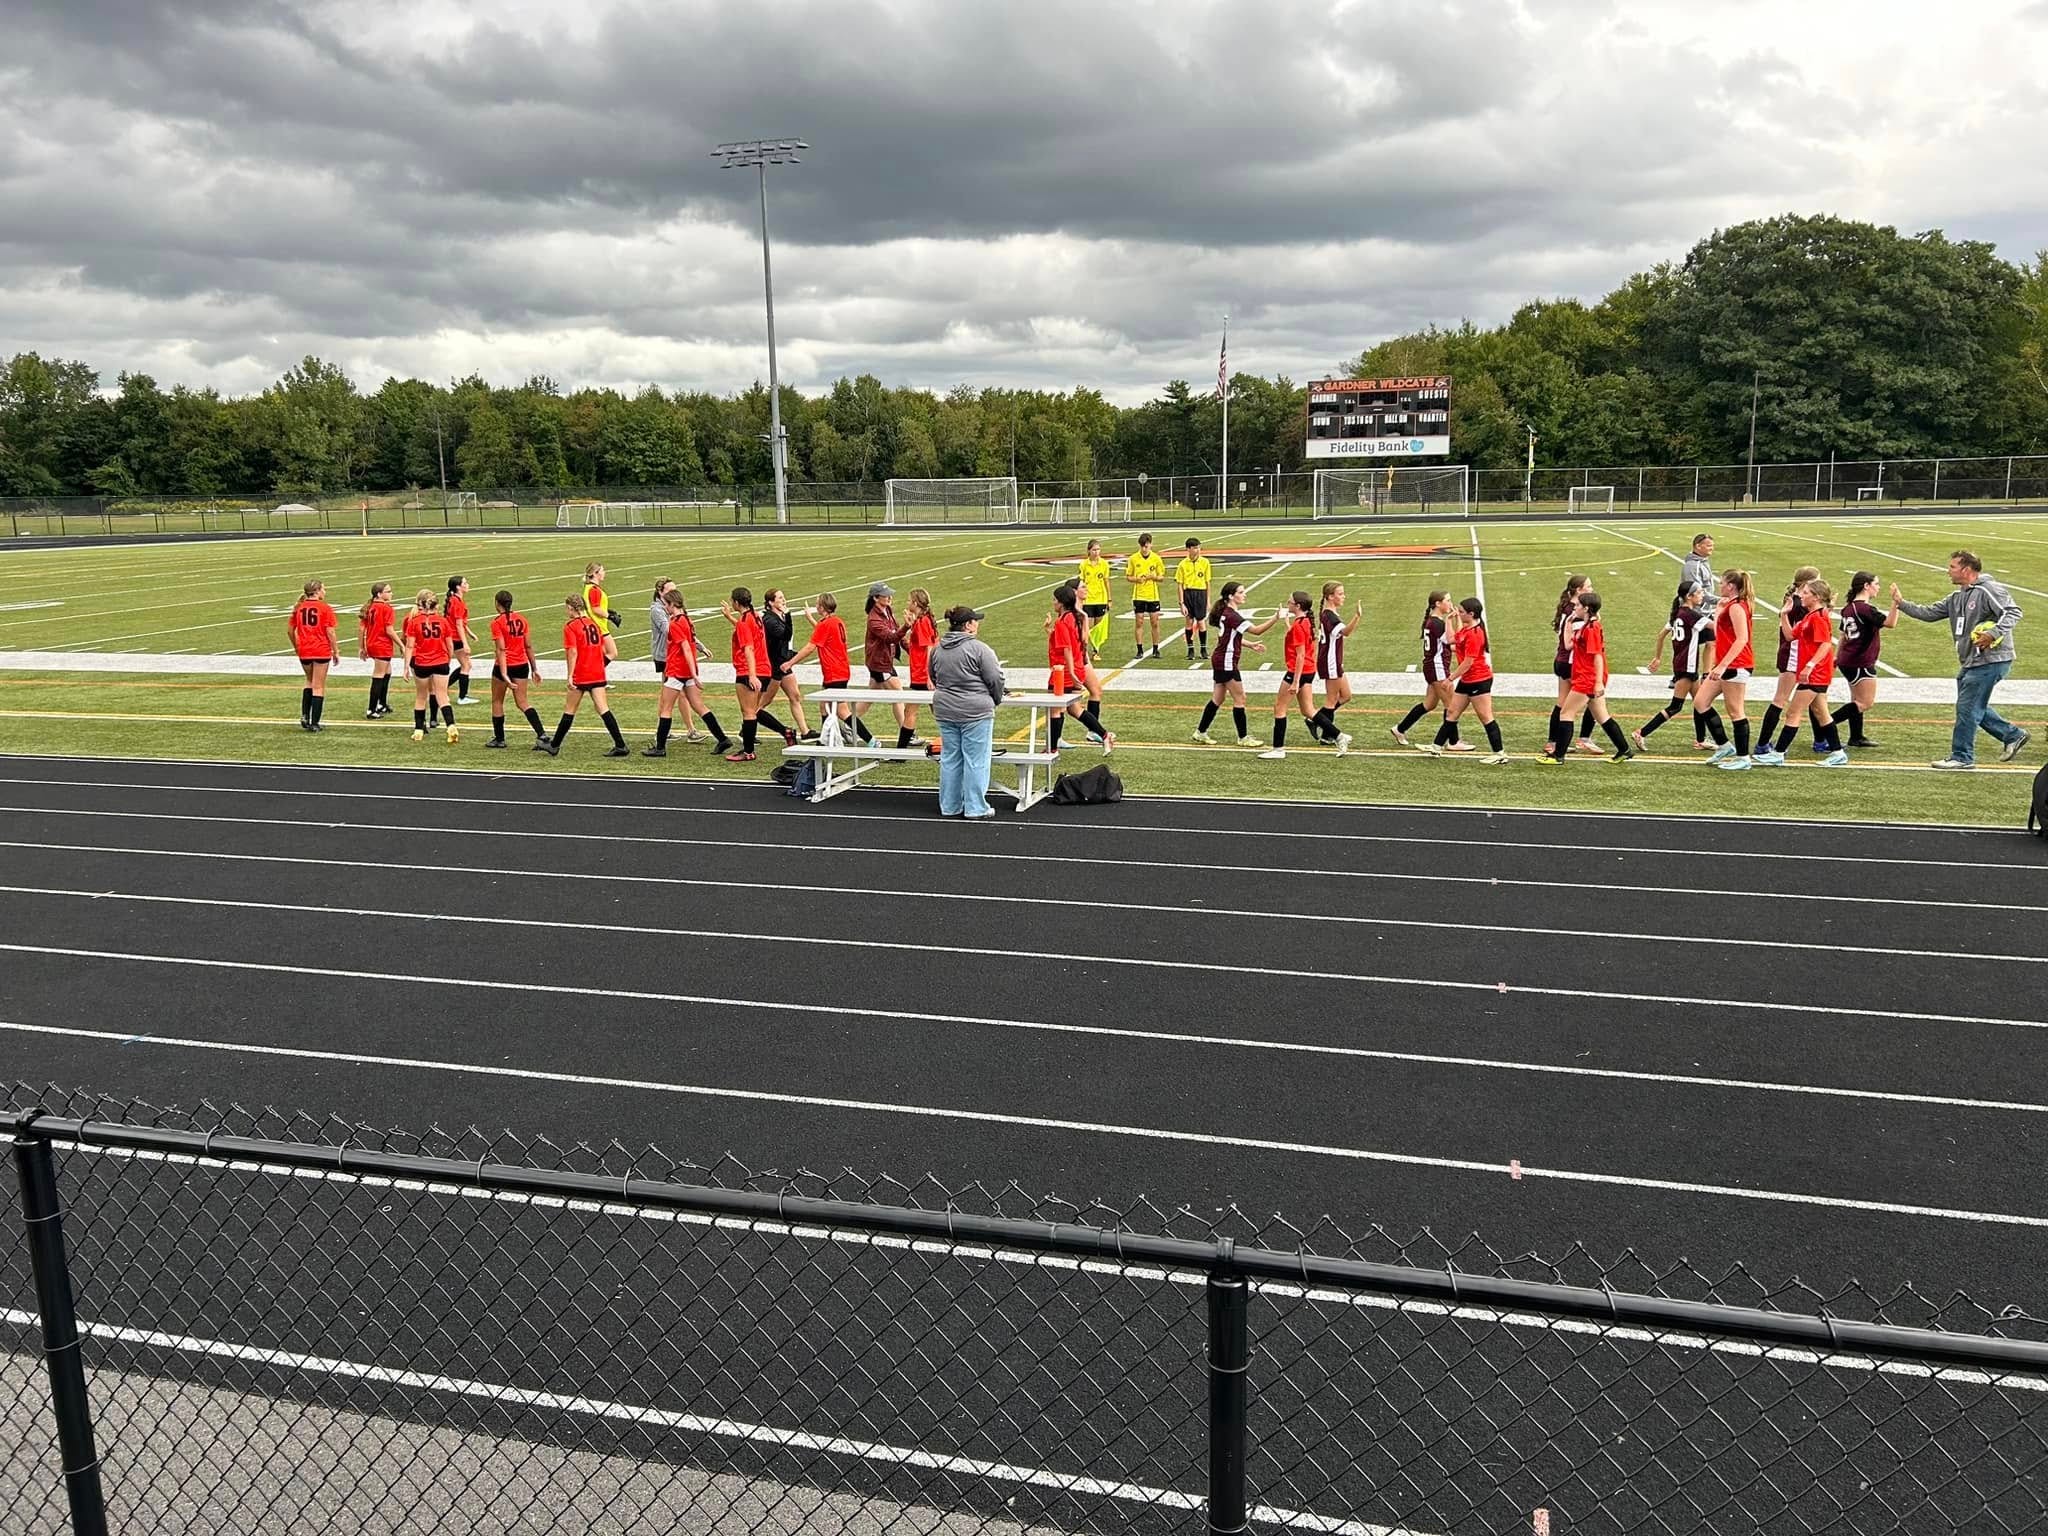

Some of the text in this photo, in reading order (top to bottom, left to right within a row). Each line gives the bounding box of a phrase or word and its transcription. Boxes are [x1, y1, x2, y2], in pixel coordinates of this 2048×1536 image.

[1324, 377, 1435, 391] GARDNER WILDCATS
[1418, 389, 1448, 399] GUESTS
[1330, 439, 1409, 454] Fidelity Bank
[300, 607, 318, 627] 16
[421, 621, 442, 639] 55
[507, 619, 524, 637] 42
[583, 624, 600, 645] 18
